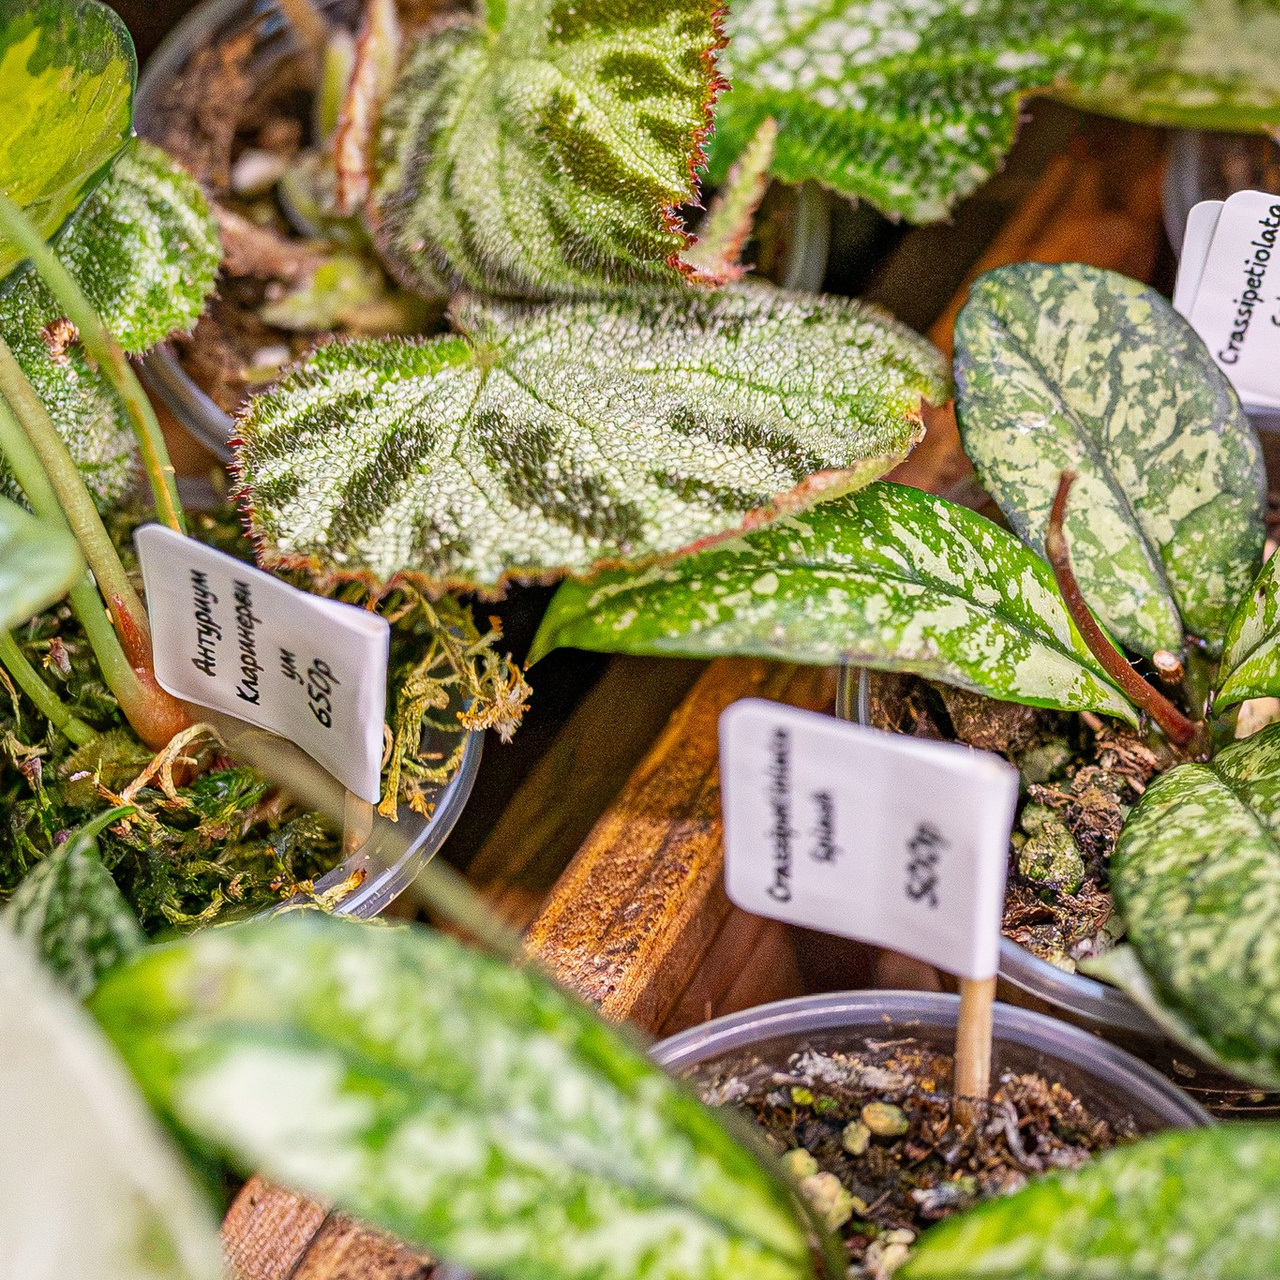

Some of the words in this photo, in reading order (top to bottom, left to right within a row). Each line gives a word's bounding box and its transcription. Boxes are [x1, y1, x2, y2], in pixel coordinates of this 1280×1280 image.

[189, 569, 222, 678] Антуриум
[233, 578, 265, 706] Кларинерви
[280, 647, 306, 688] ум
